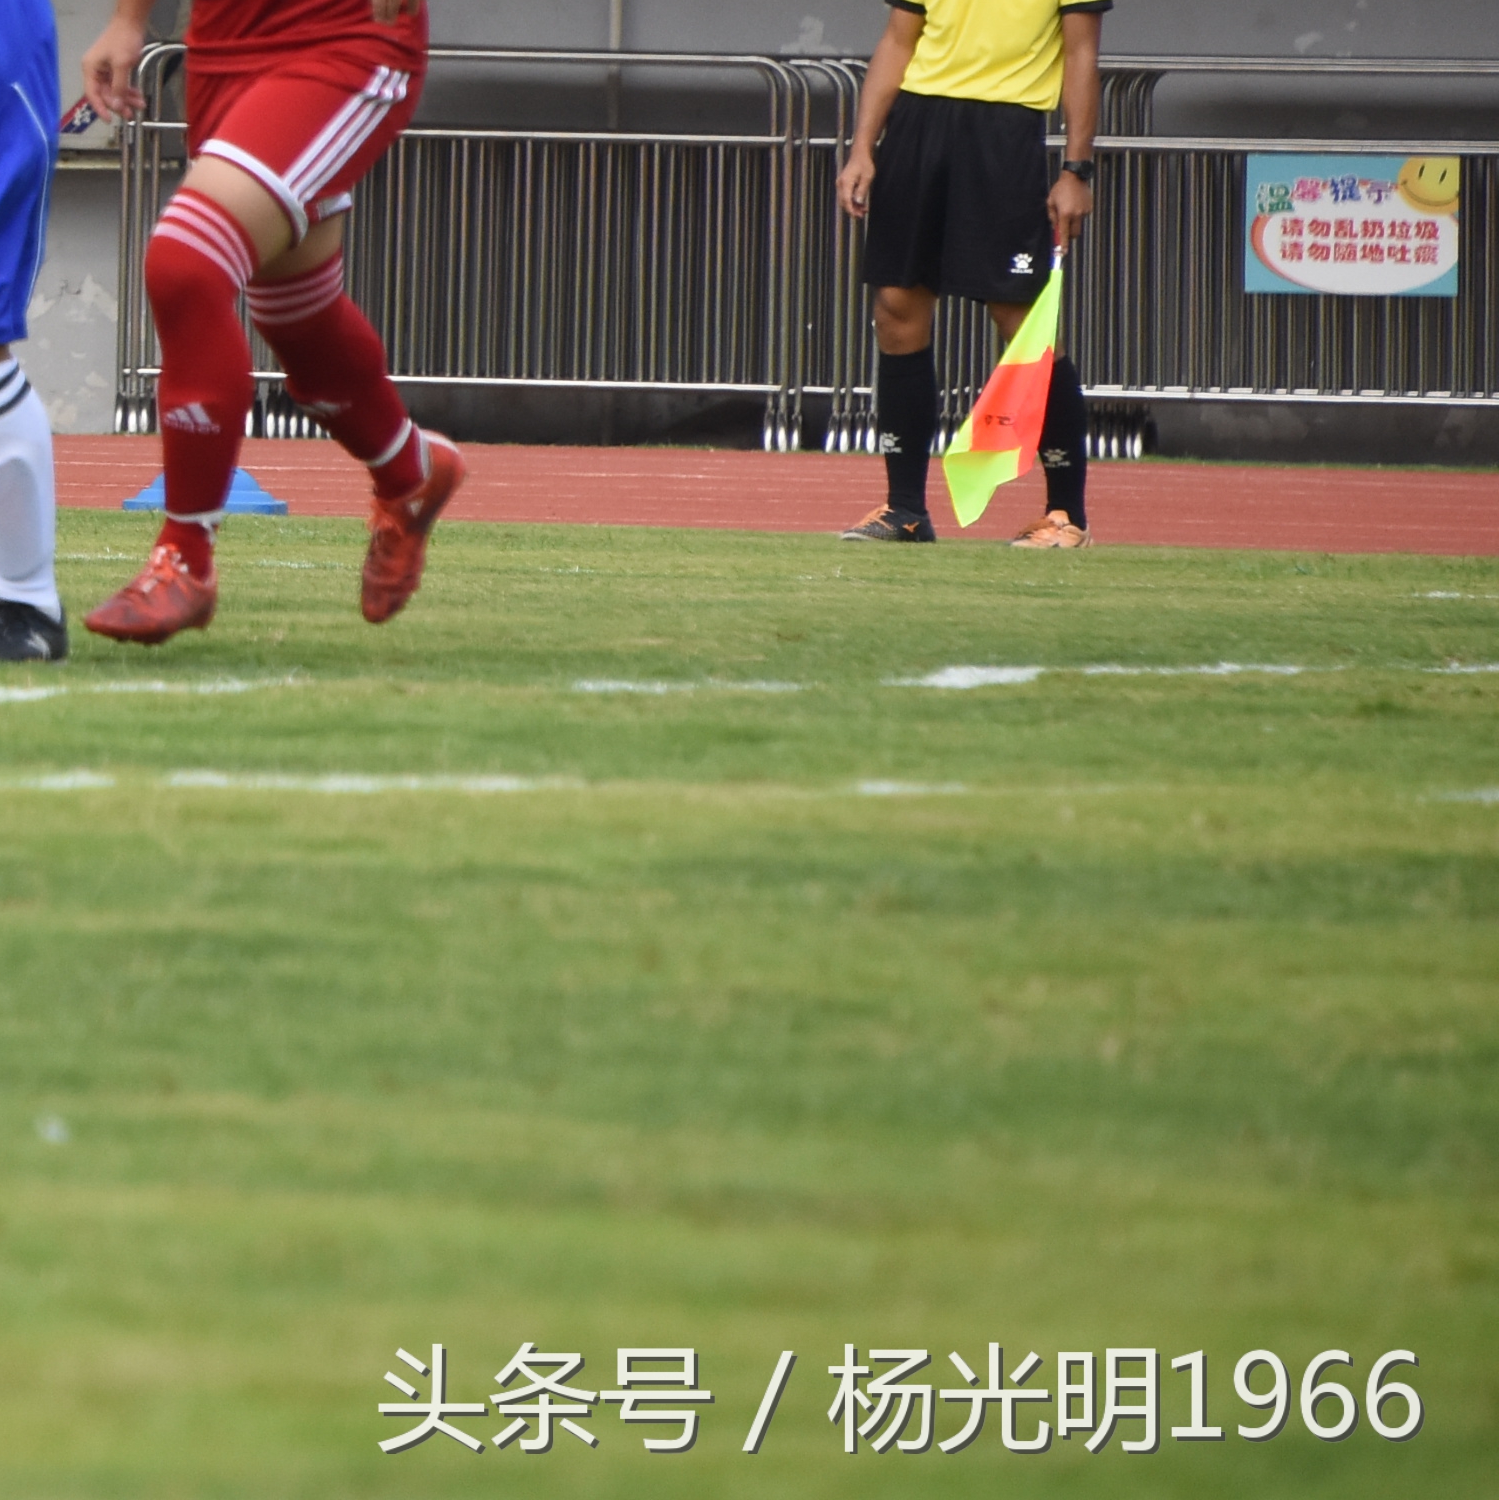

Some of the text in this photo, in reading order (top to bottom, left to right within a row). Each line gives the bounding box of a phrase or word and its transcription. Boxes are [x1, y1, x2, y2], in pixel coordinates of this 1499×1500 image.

[1256, 174, 1394, 213] 温馨提示
[1280, 217, 1440, 241] 请勿乱扔垃圾
[1280, 242, 1440, 266] 请勿随地吐痰
